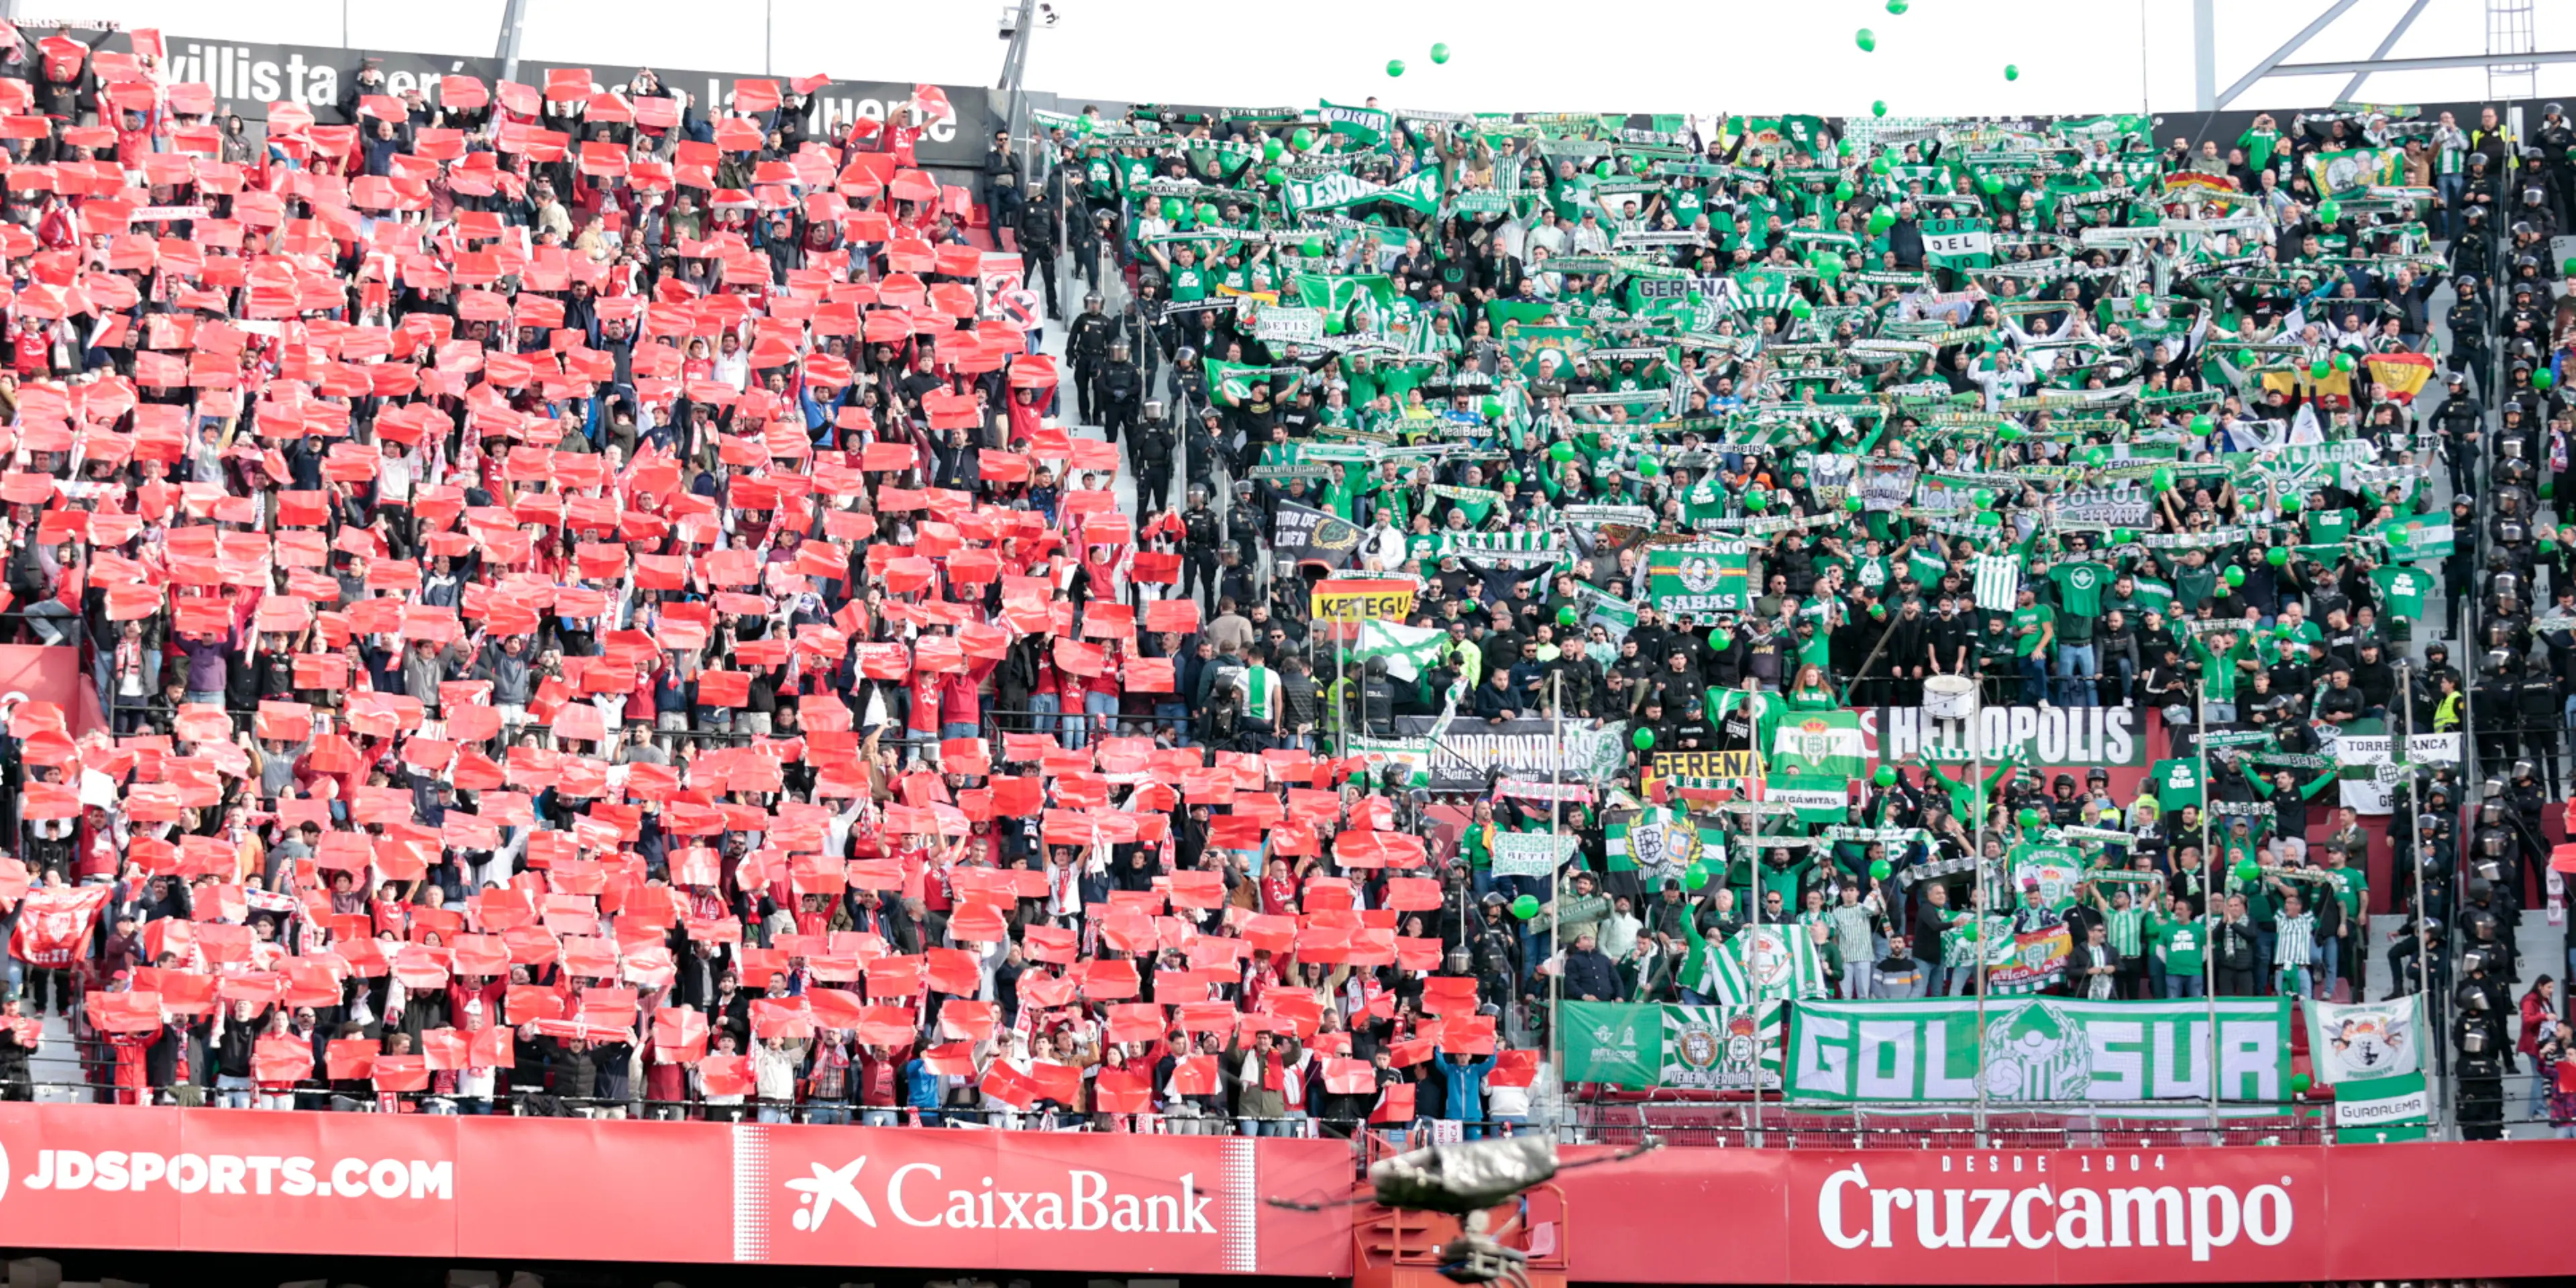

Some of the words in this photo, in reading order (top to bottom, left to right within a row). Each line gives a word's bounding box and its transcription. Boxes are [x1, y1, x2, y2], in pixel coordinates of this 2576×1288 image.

[134, 43, 337, 106] villista
[1932, 235, 1974, 251] DEL
[1859, 274, 1925, 284] BOMBEROS
[1263, 321, 1309, 331] BETIS
[1859, 487, 1907, 500] AGUADULC
[1275, 511, 1300, 527] TIRO
[1303, 512, 1321, 528] DE
[1661, 594, 1737, 610] SABAS
[1428, 733, 1595, 771] ONDICIONALES
[2347, 739, 2449, 752] TORREBLANCA
[1653, 752, 1765, 779] GERENA
[1796, 1010, 1976, 1099] GOL
[2090, 1019, 2279, 1101] SUR
[1941, 1155, 2047, 1173] DESDE
[2081, 1153, 2165, 1173] 1904
[23, 1148, 453, 1199] JDSPORTS.COM
[887, 1161, 1218, 1235] CaixaBank
[1818, 1163, 2293, 1261] Cruzcampo
